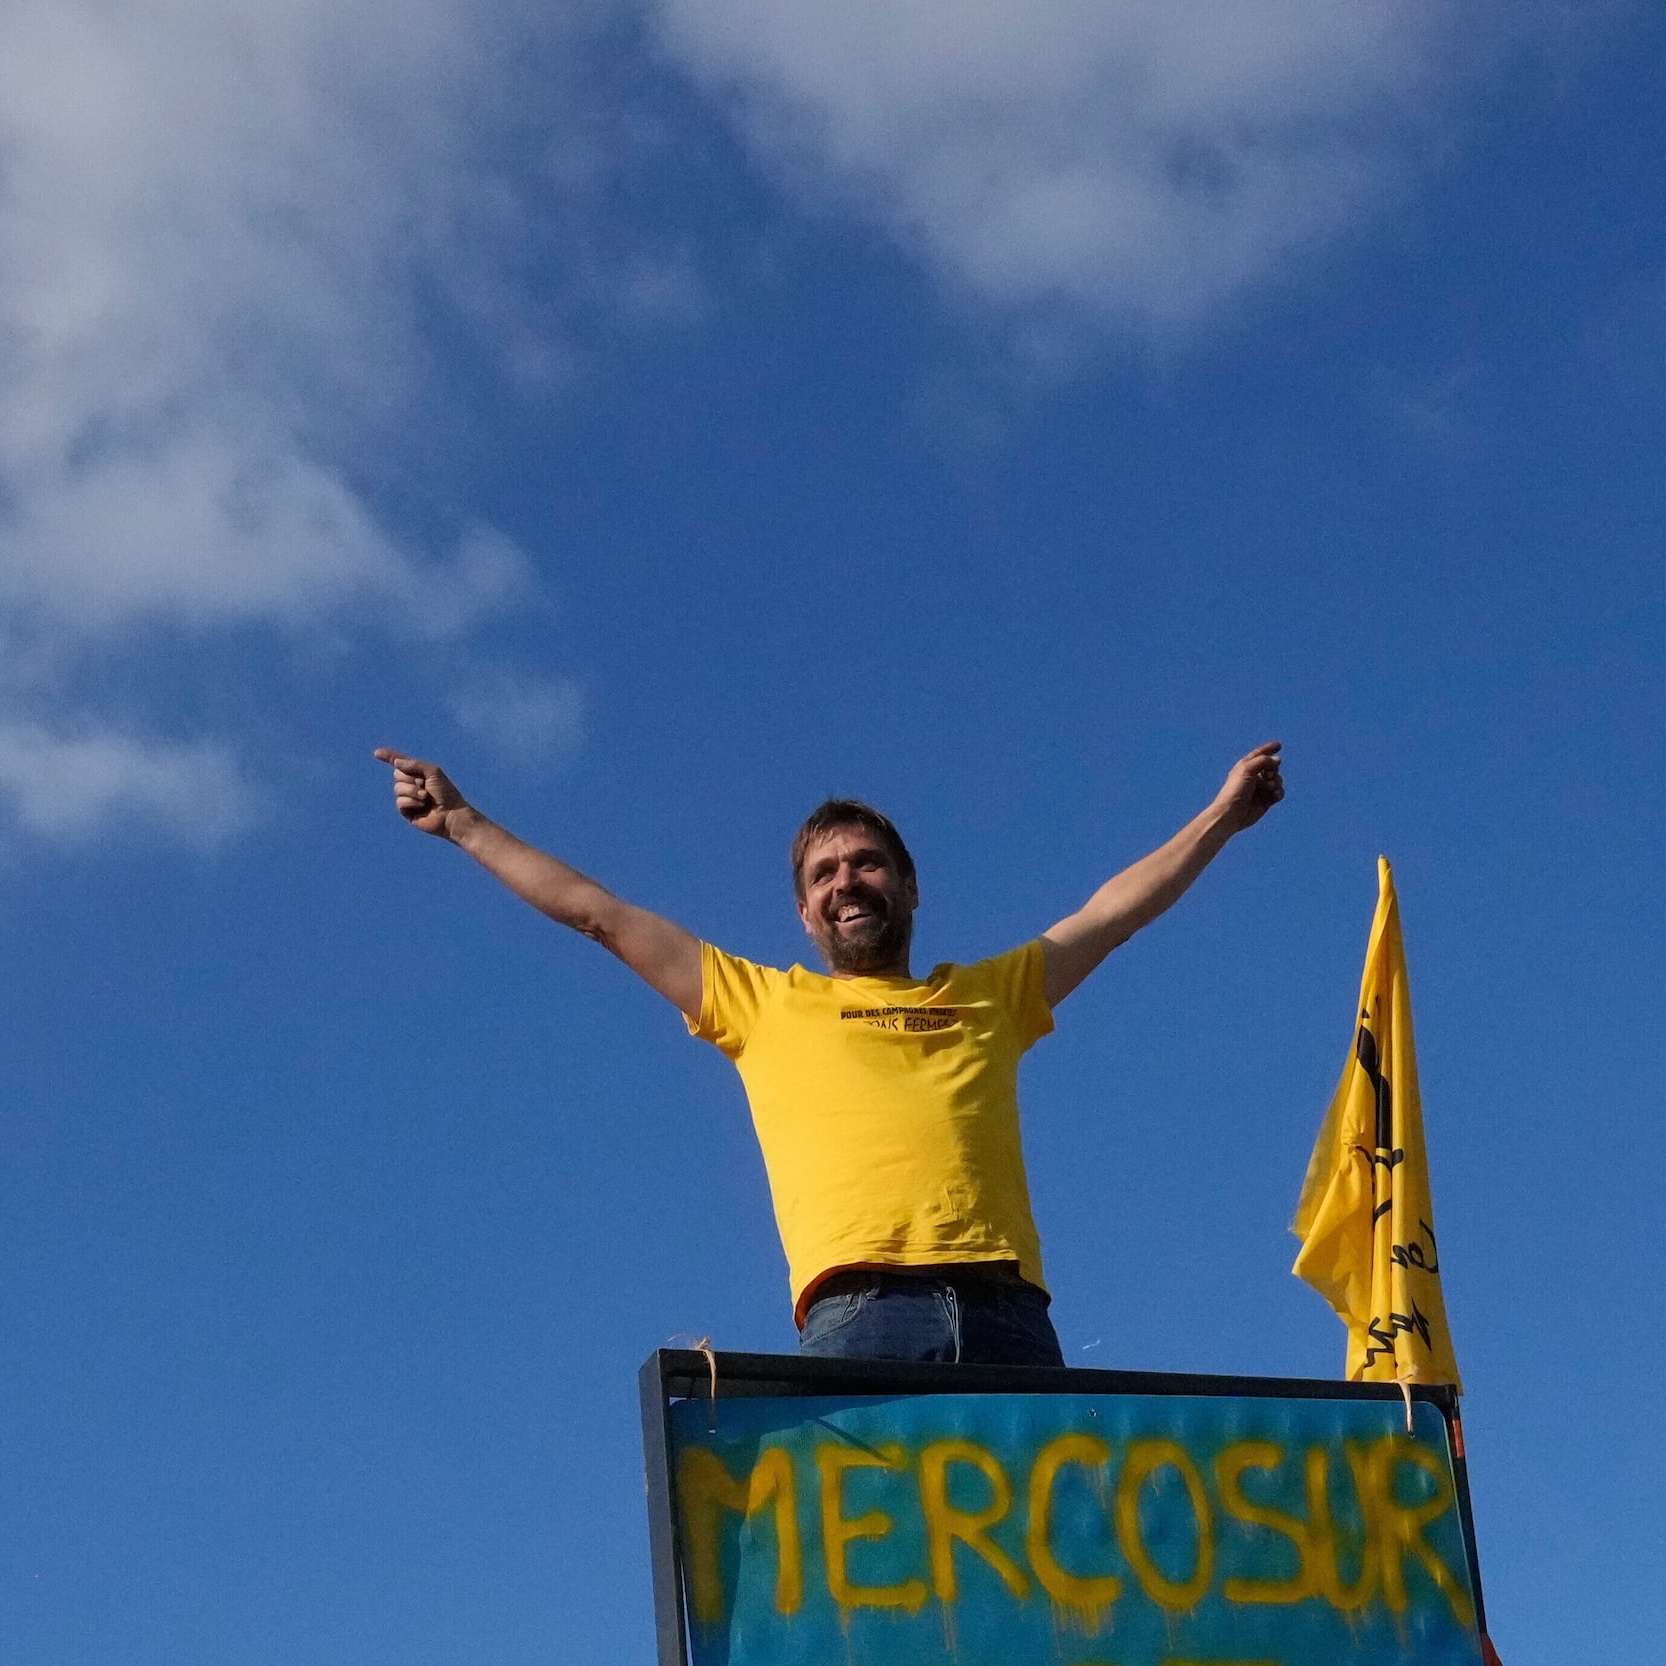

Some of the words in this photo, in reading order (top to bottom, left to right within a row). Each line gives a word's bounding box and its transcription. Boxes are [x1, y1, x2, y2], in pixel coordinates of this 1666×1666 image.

[841, 1010, 863, 1020] POUR
[865, 1008, 880, 1018] DES
[675, 1433, 1474, 1627] MERCOSUR
